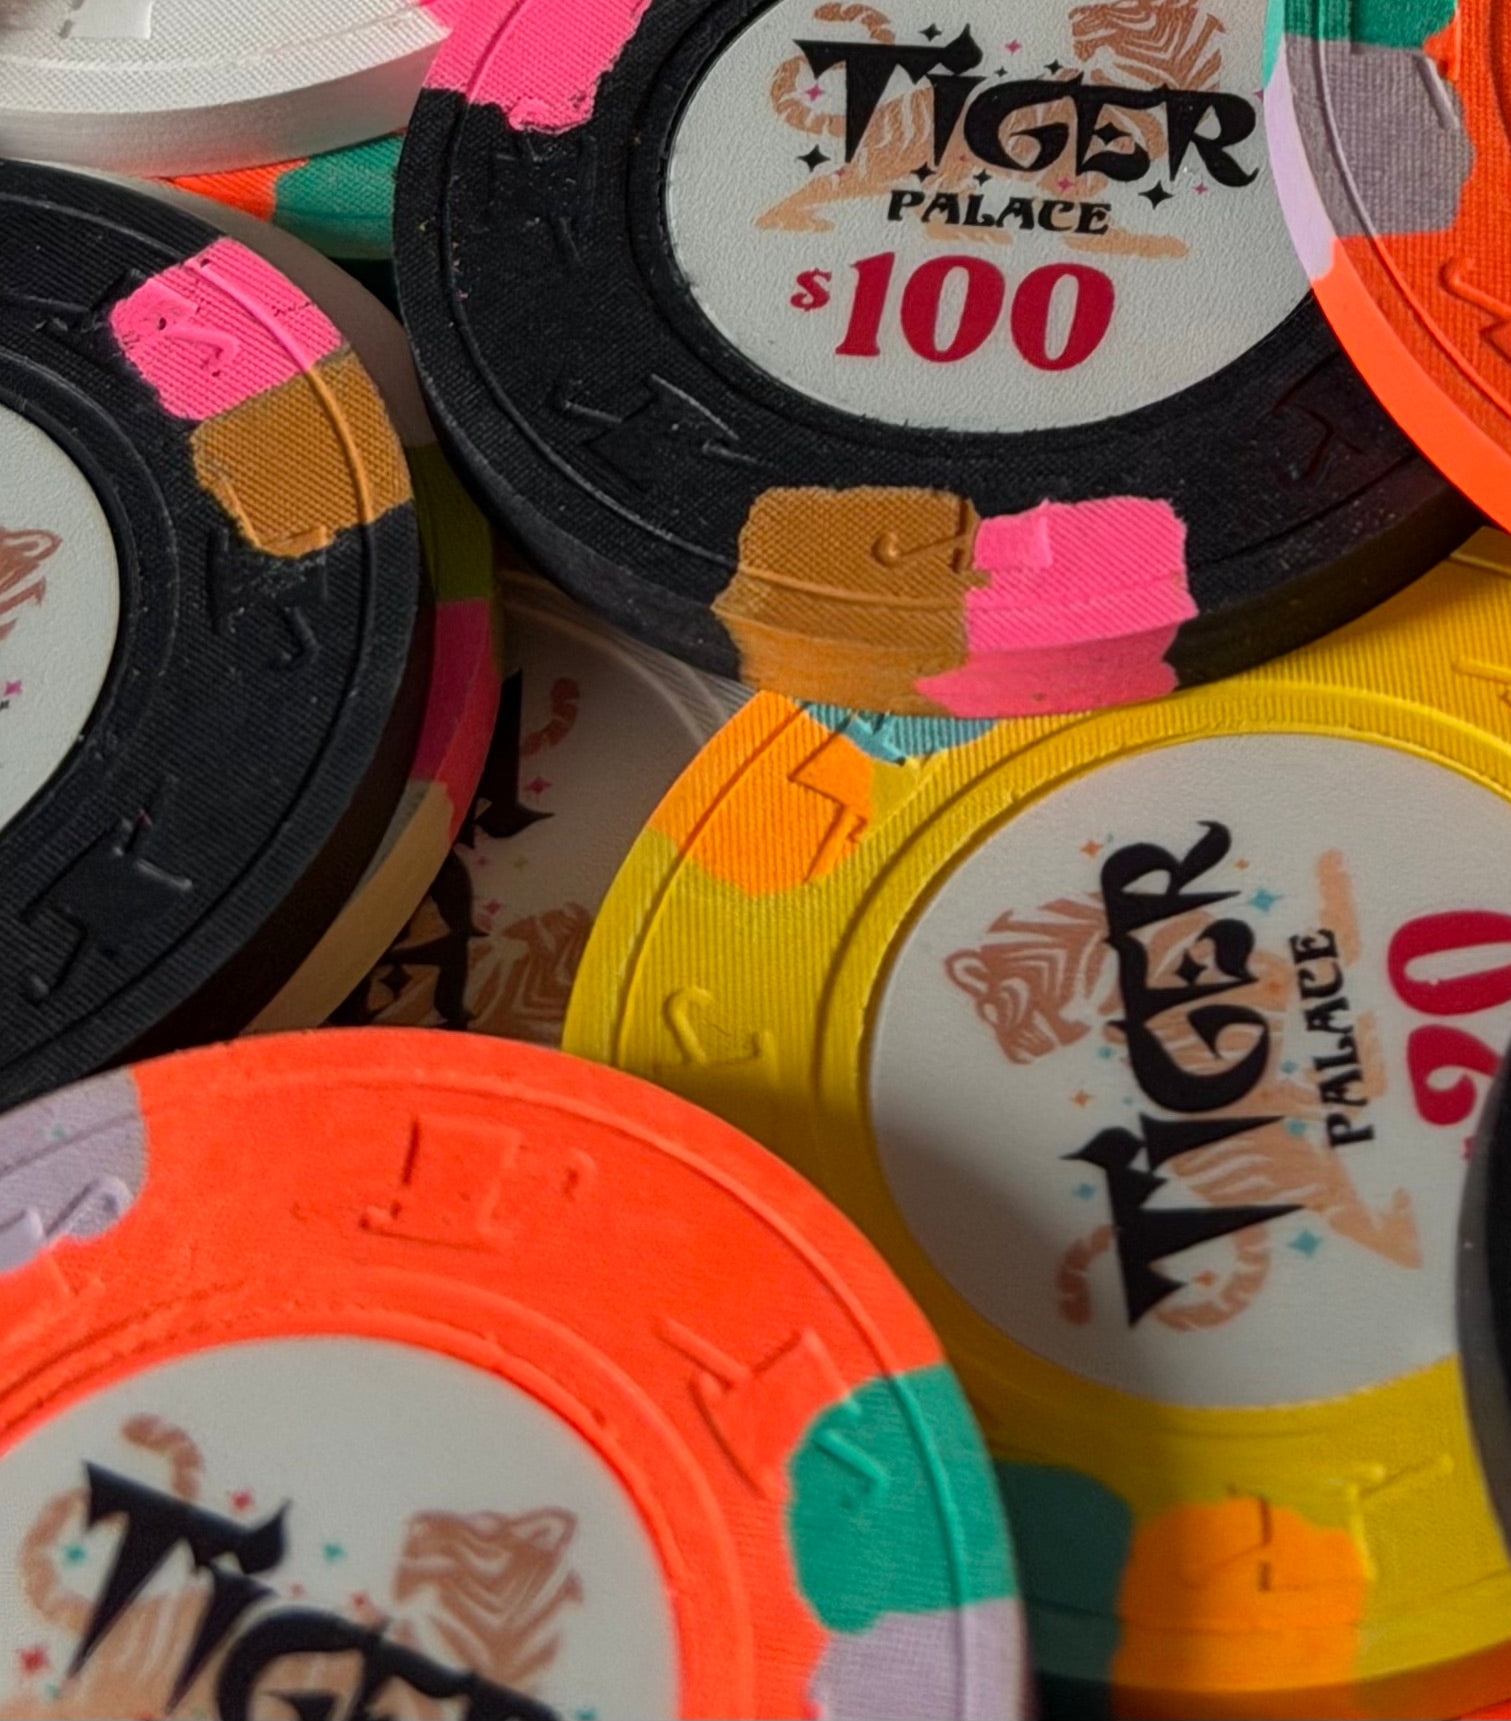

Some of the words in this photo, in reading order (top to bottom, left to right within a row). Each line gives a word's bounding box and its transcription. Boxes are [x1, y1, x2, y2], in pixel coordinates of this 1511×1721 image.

[794, 24, 1260, 188] TIGER
[887, 189, 1112, 236] PALACE
[790, 251, 1116, 372] $100
[1062, 821, 1306, 1328] TIGER
[1288, 929, 1375, 1148] PALACE
